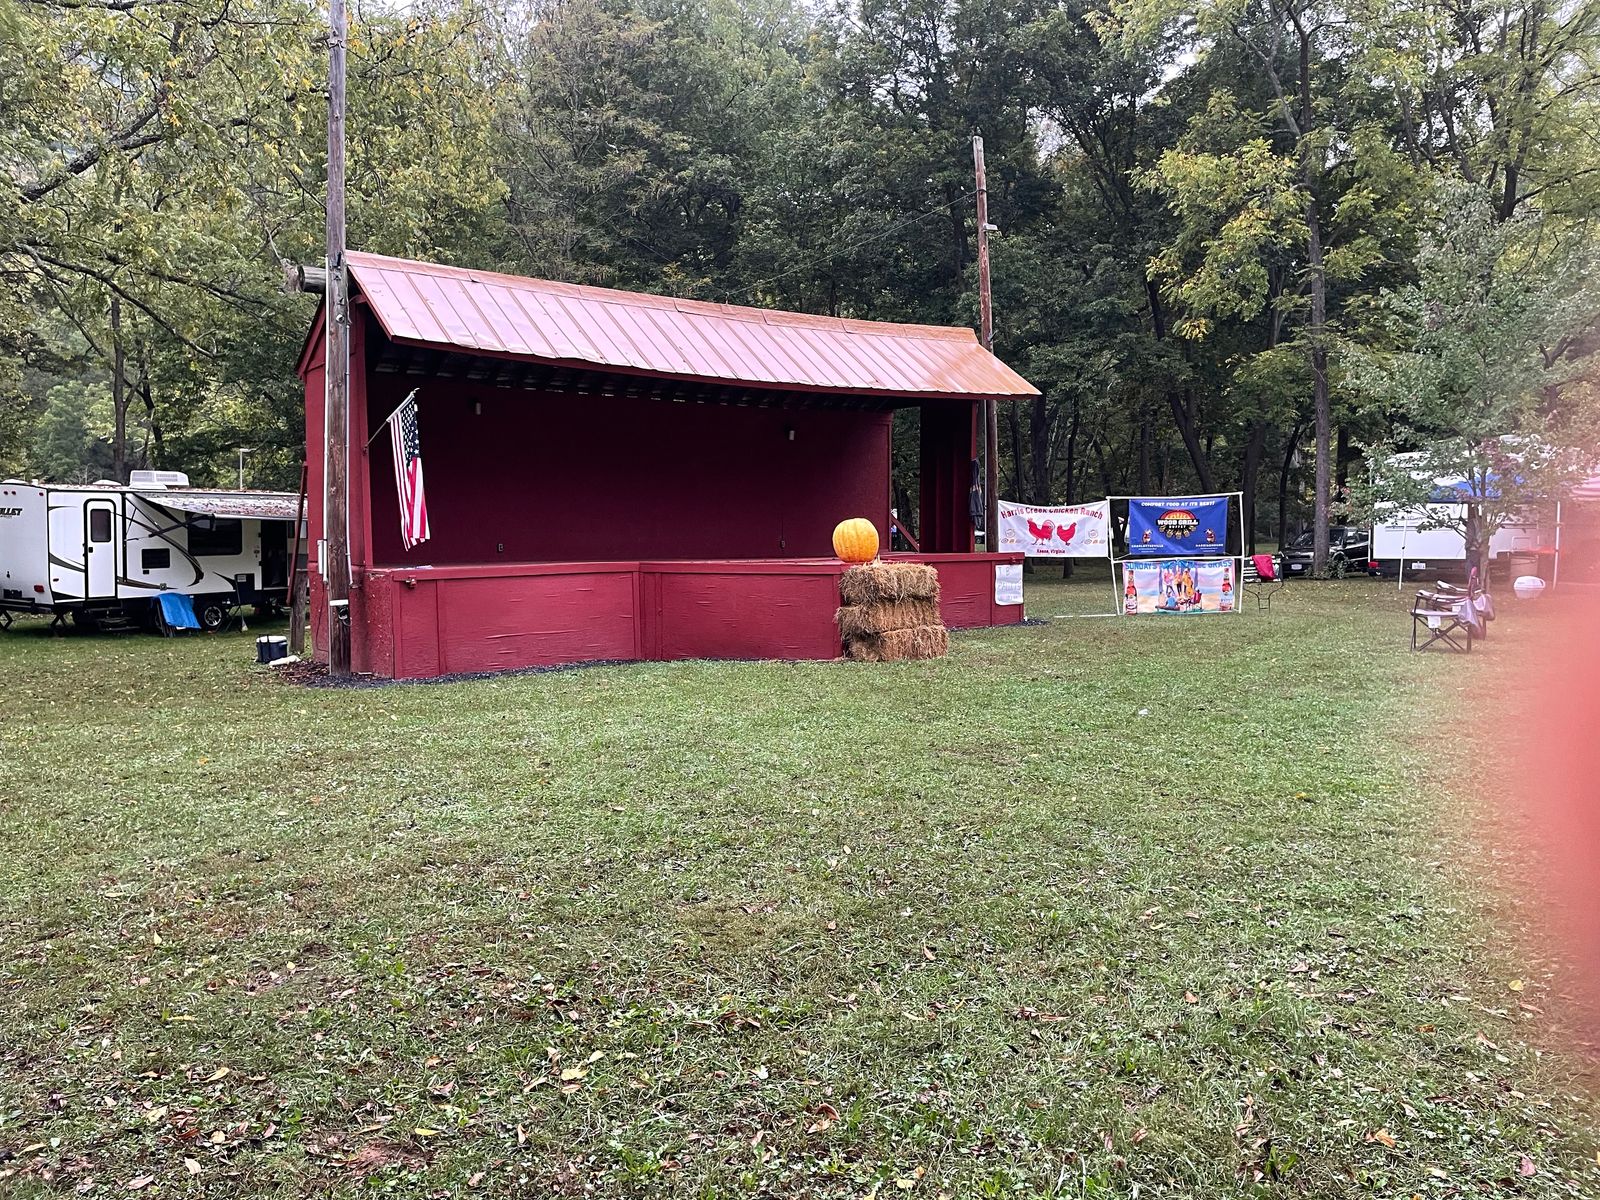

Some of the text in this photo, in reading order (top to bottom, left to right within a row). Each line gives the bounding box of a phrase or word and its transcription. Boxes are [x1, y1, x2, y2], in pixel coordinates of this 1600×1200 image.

[1000, 508, 1024, 519] Harris
[1080, 507, 1103, 519] Ranch
[1125, 562, 1157, 570] SUNDAYS
